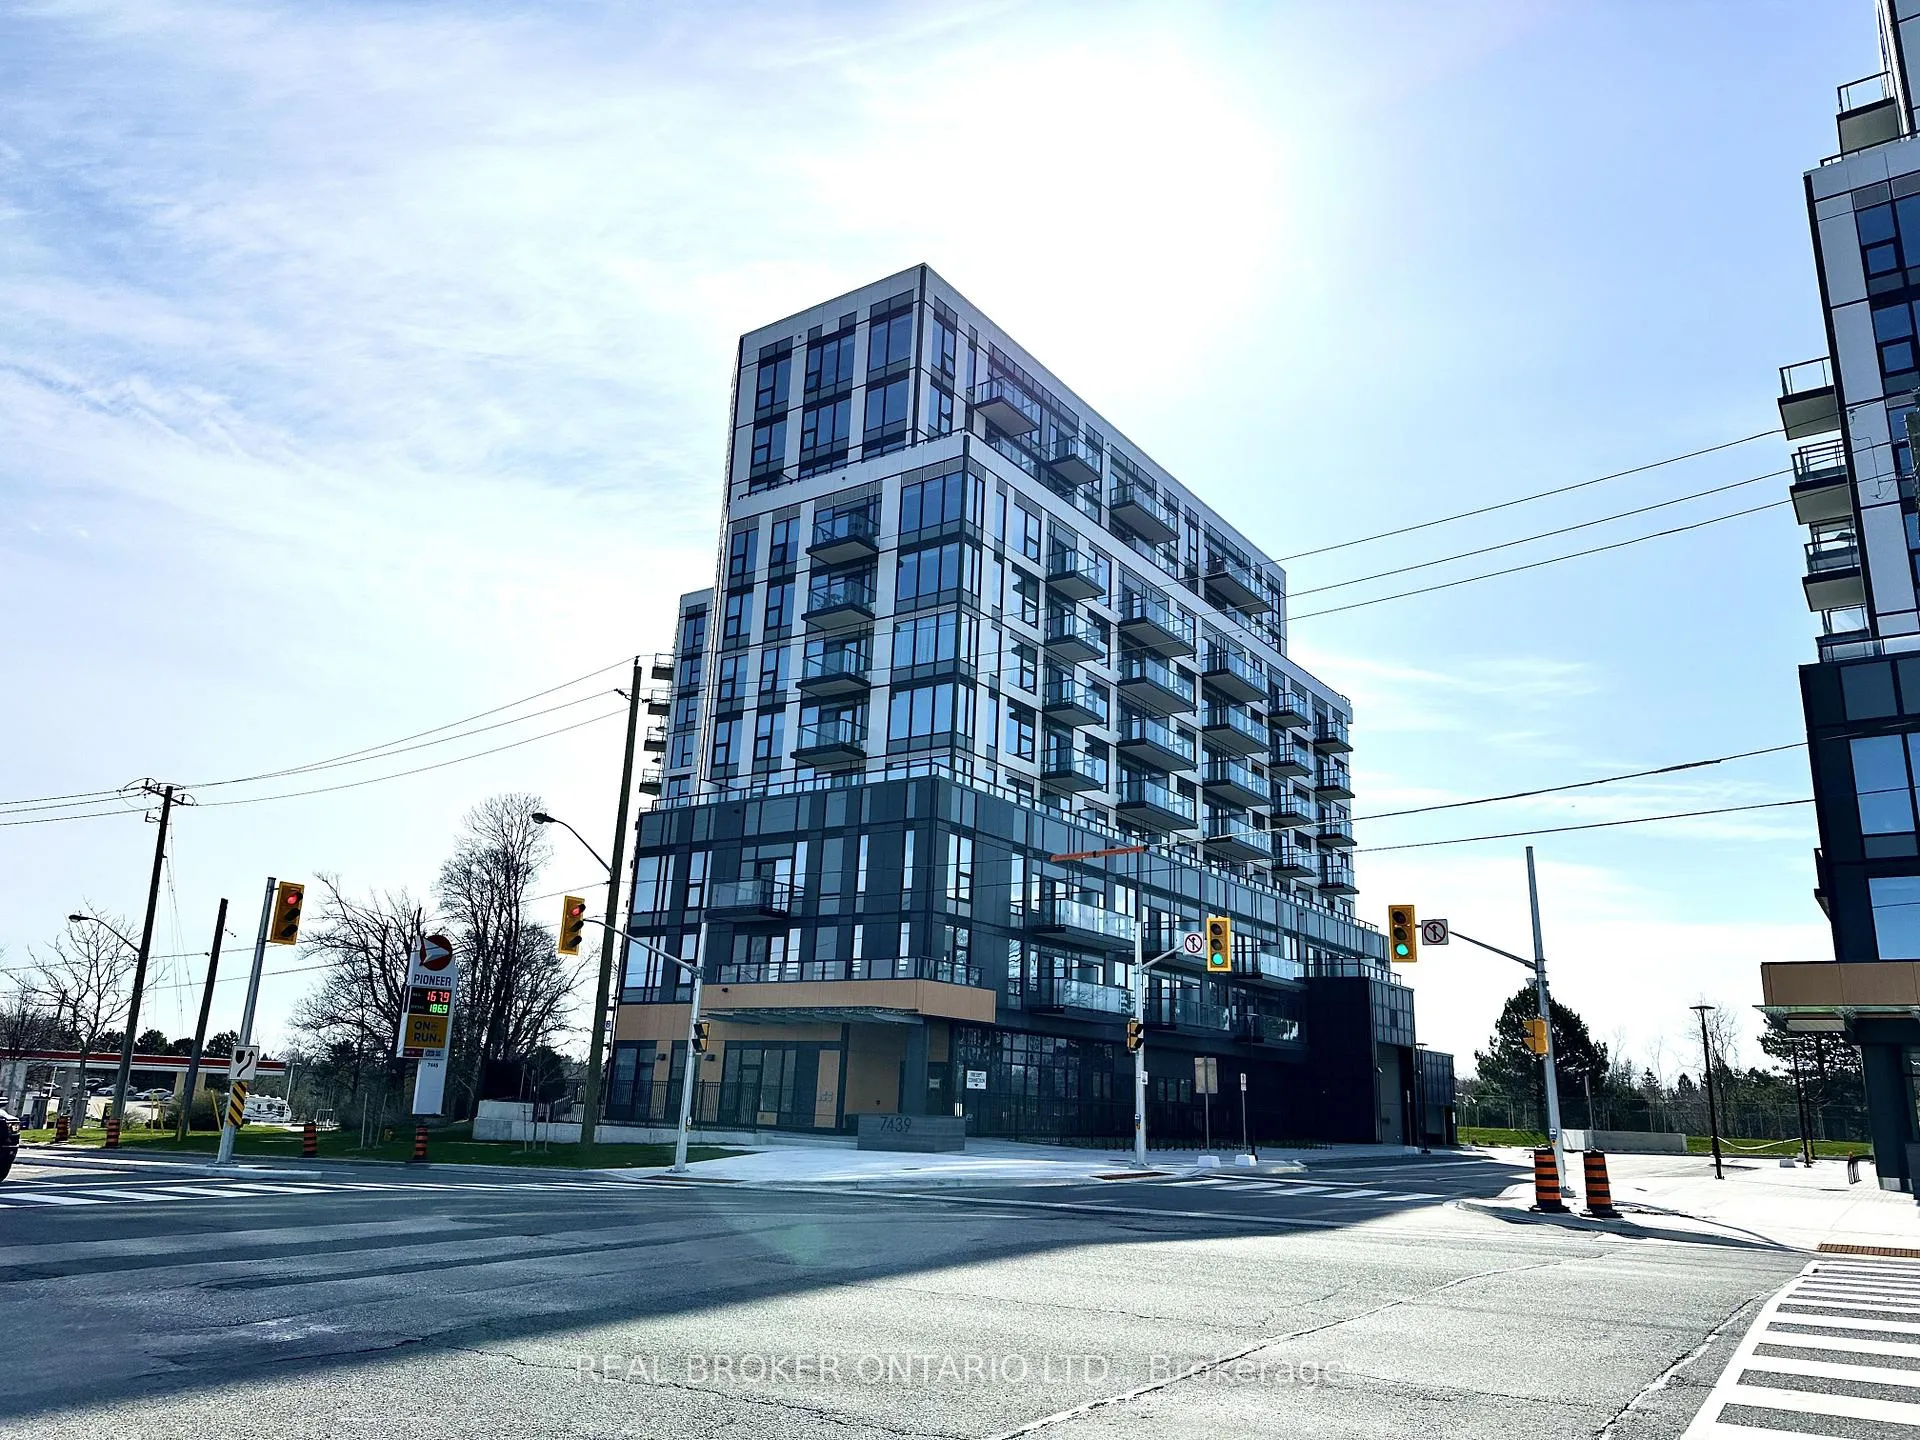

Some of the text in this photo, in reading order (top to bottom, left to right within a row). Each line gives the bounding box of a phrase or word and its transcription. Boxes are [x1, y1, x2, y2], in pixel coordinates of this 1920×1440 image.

[413, 974, 452, 986] PIONEER
[414, 1021, 431, 1030] ON
[880, 1116, 912, 1133] 7439
